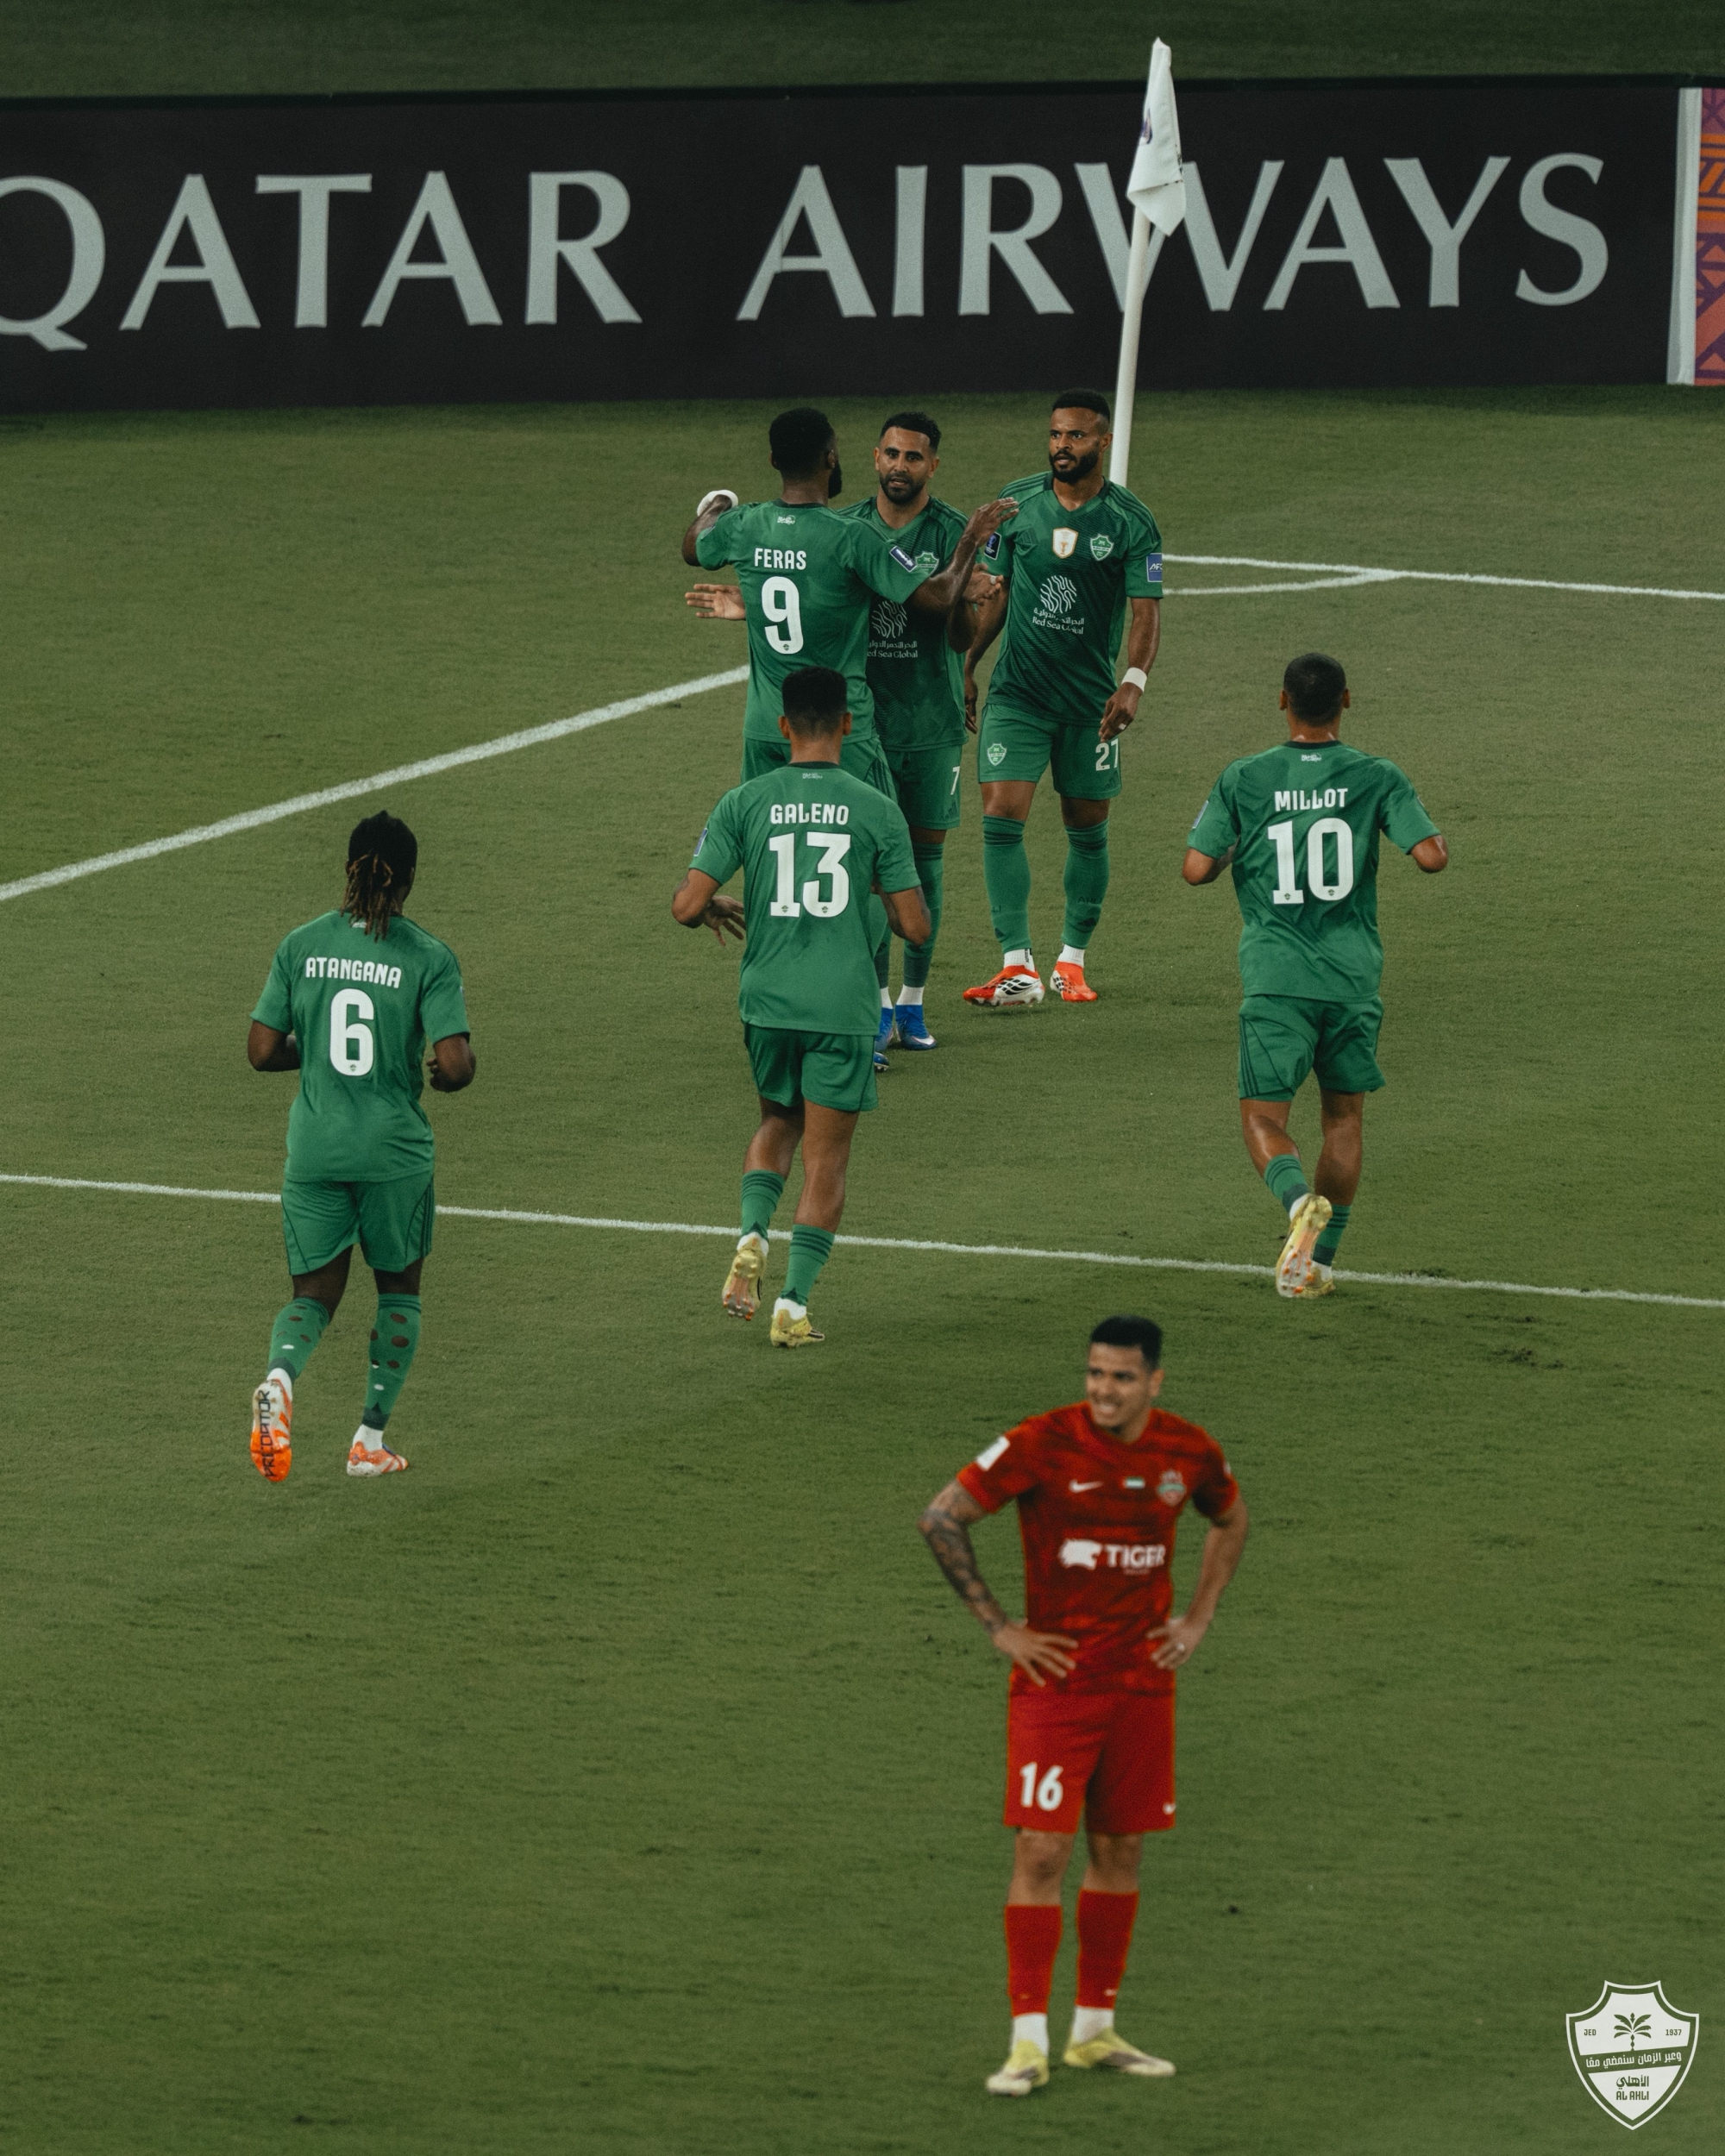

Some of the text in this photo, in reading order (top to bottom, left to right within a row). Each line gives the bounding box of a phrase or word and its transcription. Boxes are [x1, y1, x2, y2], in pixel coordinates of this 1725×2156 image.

[0, 153, 1610, 352] QATAR AIRWAYS
[754, 548, 807, 570] FERAS
[762, 576, 804, 655] 9
[1032, 616, 1084, 635] Red Sea Gbal
[894, 649, 919, 658] Global
[1095, 738, 1119, 771] 27
[950, 766, 961, 795] 7
[770, 803, 850, 825] GALENO
[1274, 788, 1348, 812] MILLOT
[768, 831, 851, 918] 13
[1267, 817, 1354, 905] 10
[305, 956, 402, 989] ATANGANA
[329, 988, 374, 1076] 6
[1106, 1544, 1166, 1568] TIGER
[1019, 1761, 1064, 1812] 16
